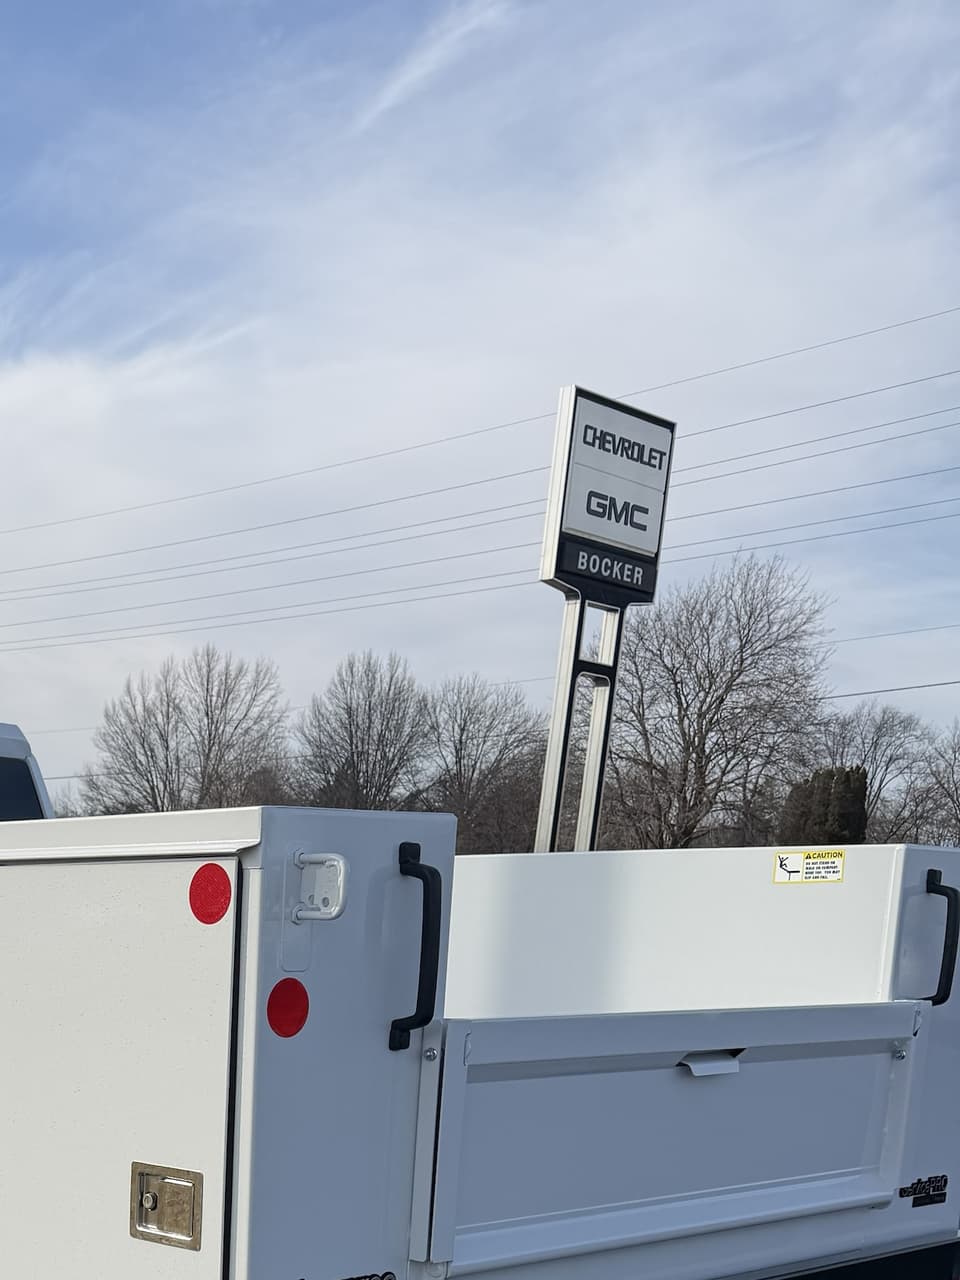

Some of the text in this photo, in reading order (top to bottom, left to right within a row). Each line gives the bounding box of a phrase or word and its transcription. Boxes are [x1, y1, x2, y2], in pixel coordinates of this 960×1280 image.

[583, 424, 667, 470] CHEVROLET
[586, 490, 649, 532] GMC
[577, 551, 644, 585] BOCKER
[812, 851, 843, 859] CAUTION
